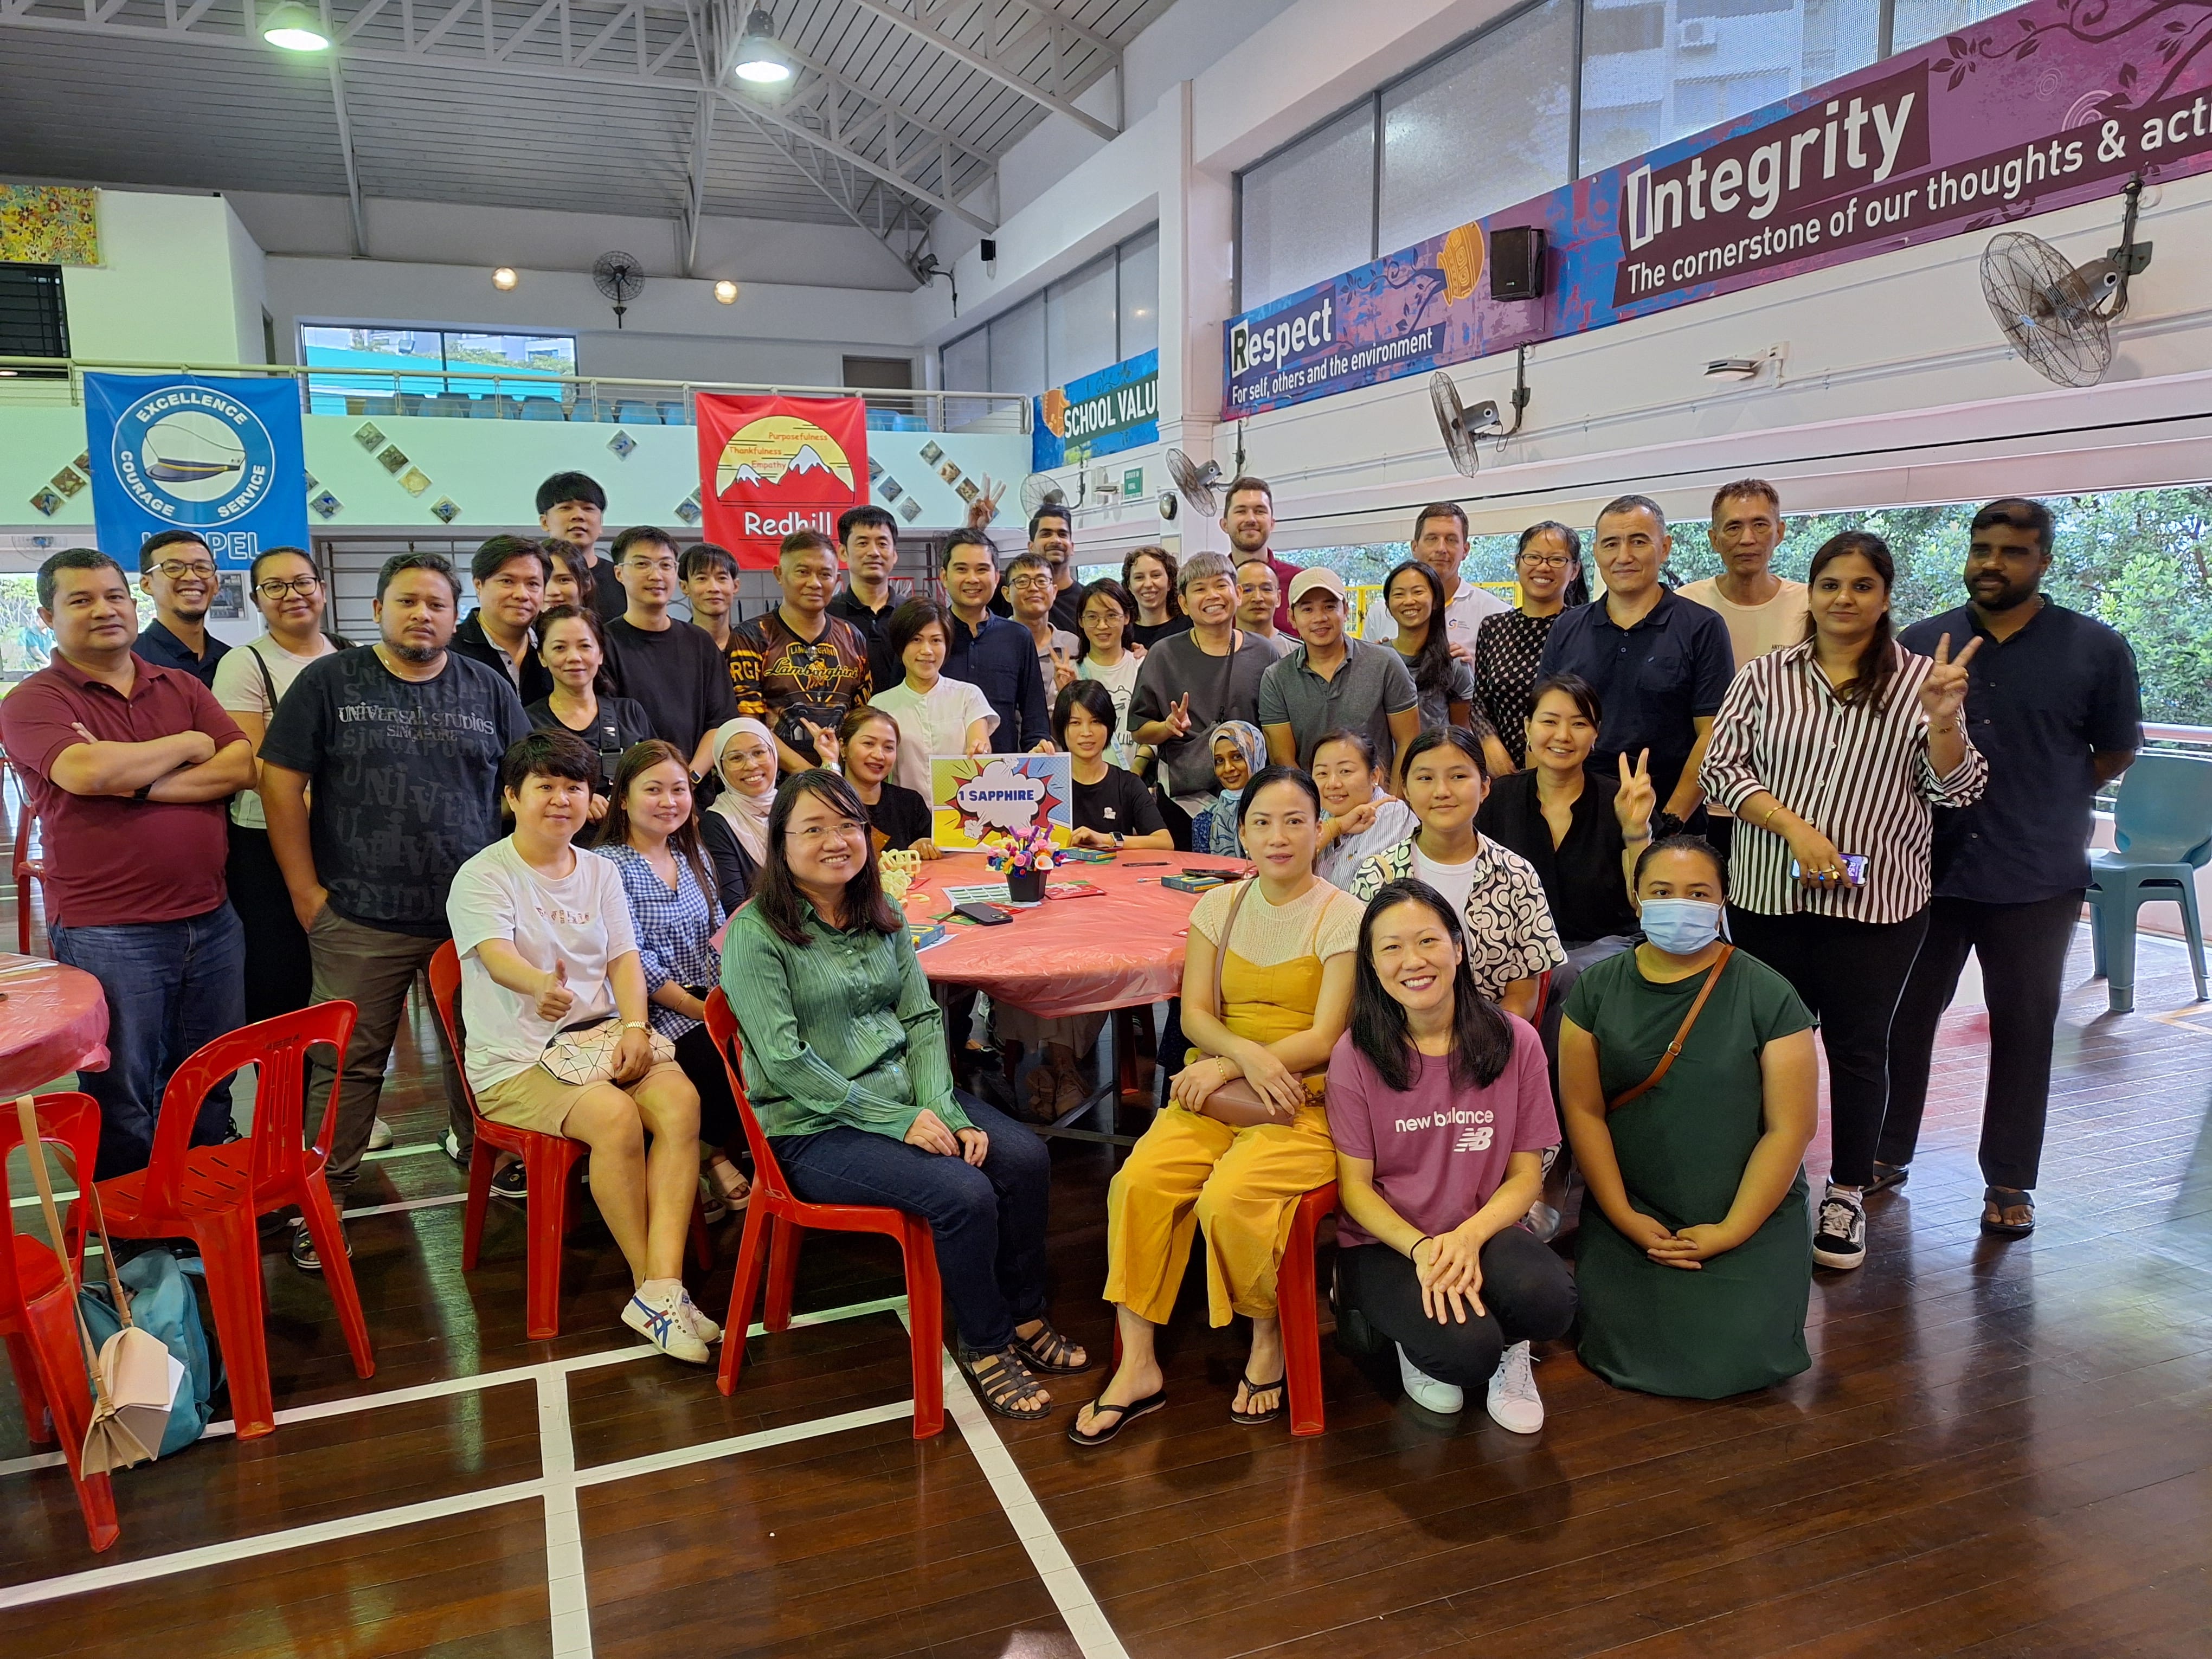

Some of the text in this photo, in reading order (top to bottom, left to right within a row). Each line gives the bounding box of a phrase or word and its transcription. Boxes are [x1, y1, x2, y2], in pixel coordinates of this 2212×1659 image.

[1627, 92, 1915, 250] Integrity
[1628, 263, 1665, 294] The
[1672, 218, 1821, 279] cornerstone
[1830, 197, 1857, 237] of
[1865, 189, 1918, 227] our
[1927, 140, 2083, 211] thoughts
[2097, 119, 2126, 163] &
[1231, 298, 1332, 378] Respect
[1232, 330, 1432, 405] For self, others and the environment
[136, 392, 248, 426] EXCELLENCE
[1064, 380, 1159, 439] SCHOOL VALU
[730, 447, 781, 455] Thankfulness
[769, 432, 828, 441] Purposefulness
[120, 450, 176, 517] COURAGE
[751, 460, 786, 470] Empathy
[217, 464, 266, 518] SERVICE
[744, 512, 832, 536] Redhill
[959, 789, 1034, 801] 1 SAPPHIRE
[1394, 1107, 1494, 1133] new balance
